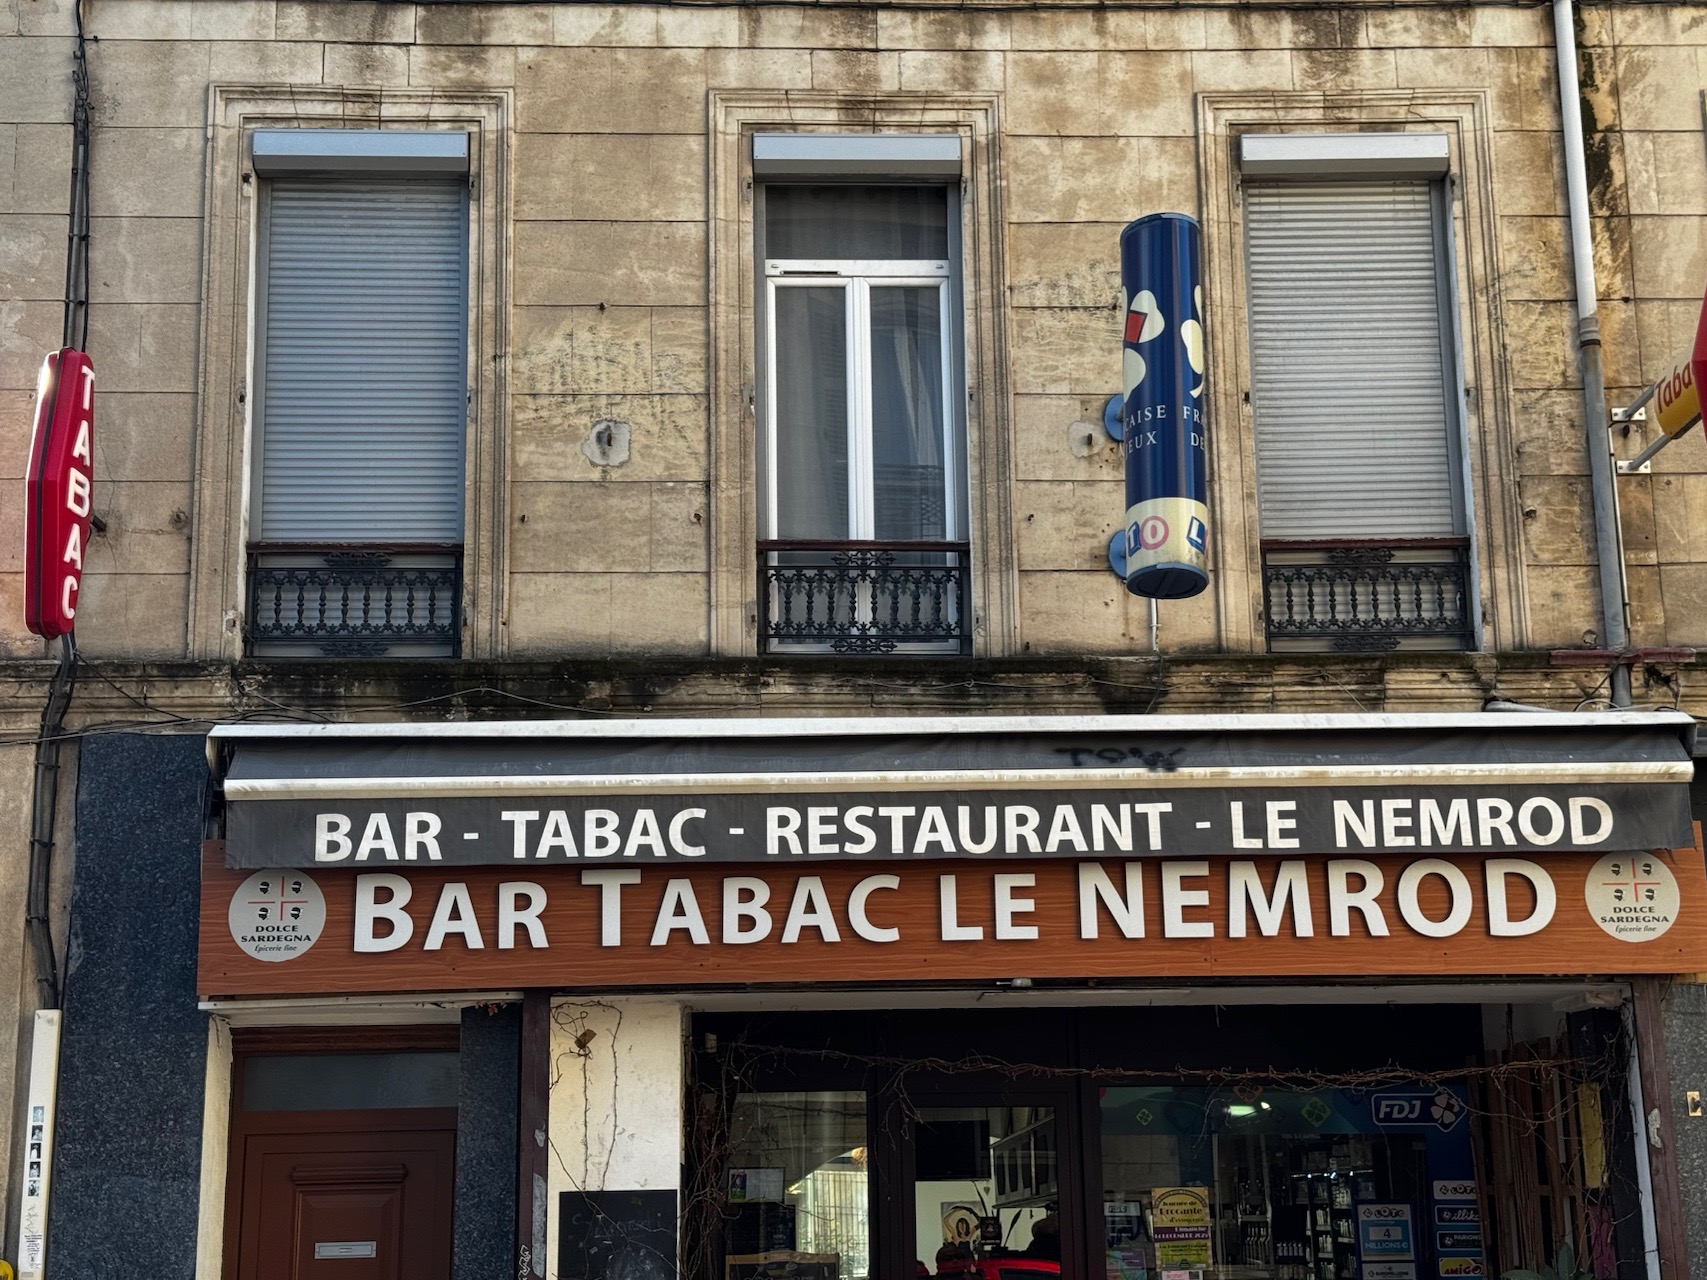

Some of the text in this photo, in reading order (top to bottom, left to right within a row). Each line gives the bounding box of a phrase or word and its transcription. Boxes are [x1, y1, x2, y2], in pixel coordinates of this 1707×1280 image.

[61, 364, 96, 620] TABAC
[314, 812, 443, 862] BAR
[501, 808, 707, 859] TABAC
[766, 803, 1172, 855] RESTAURANT
[1230, 800, 1301, 849] LE
[1333, 796, 1614, 848] NEMROD
[353, 858, 1557, 952] BAR TABAC LE NEMROD
[1612, 906, 1655, 914] DOLCE
[1600, 915, 1670, 923] SARDEGNA
[255, 924, 299, 933] DOLCE
[240, 934, 312, 943] SARDEGNA
[283, 944, 298, 952] fine
[1378, 1099, 1422, 1119] FDJ
[1383, 1228, 1392, 1238] 4
